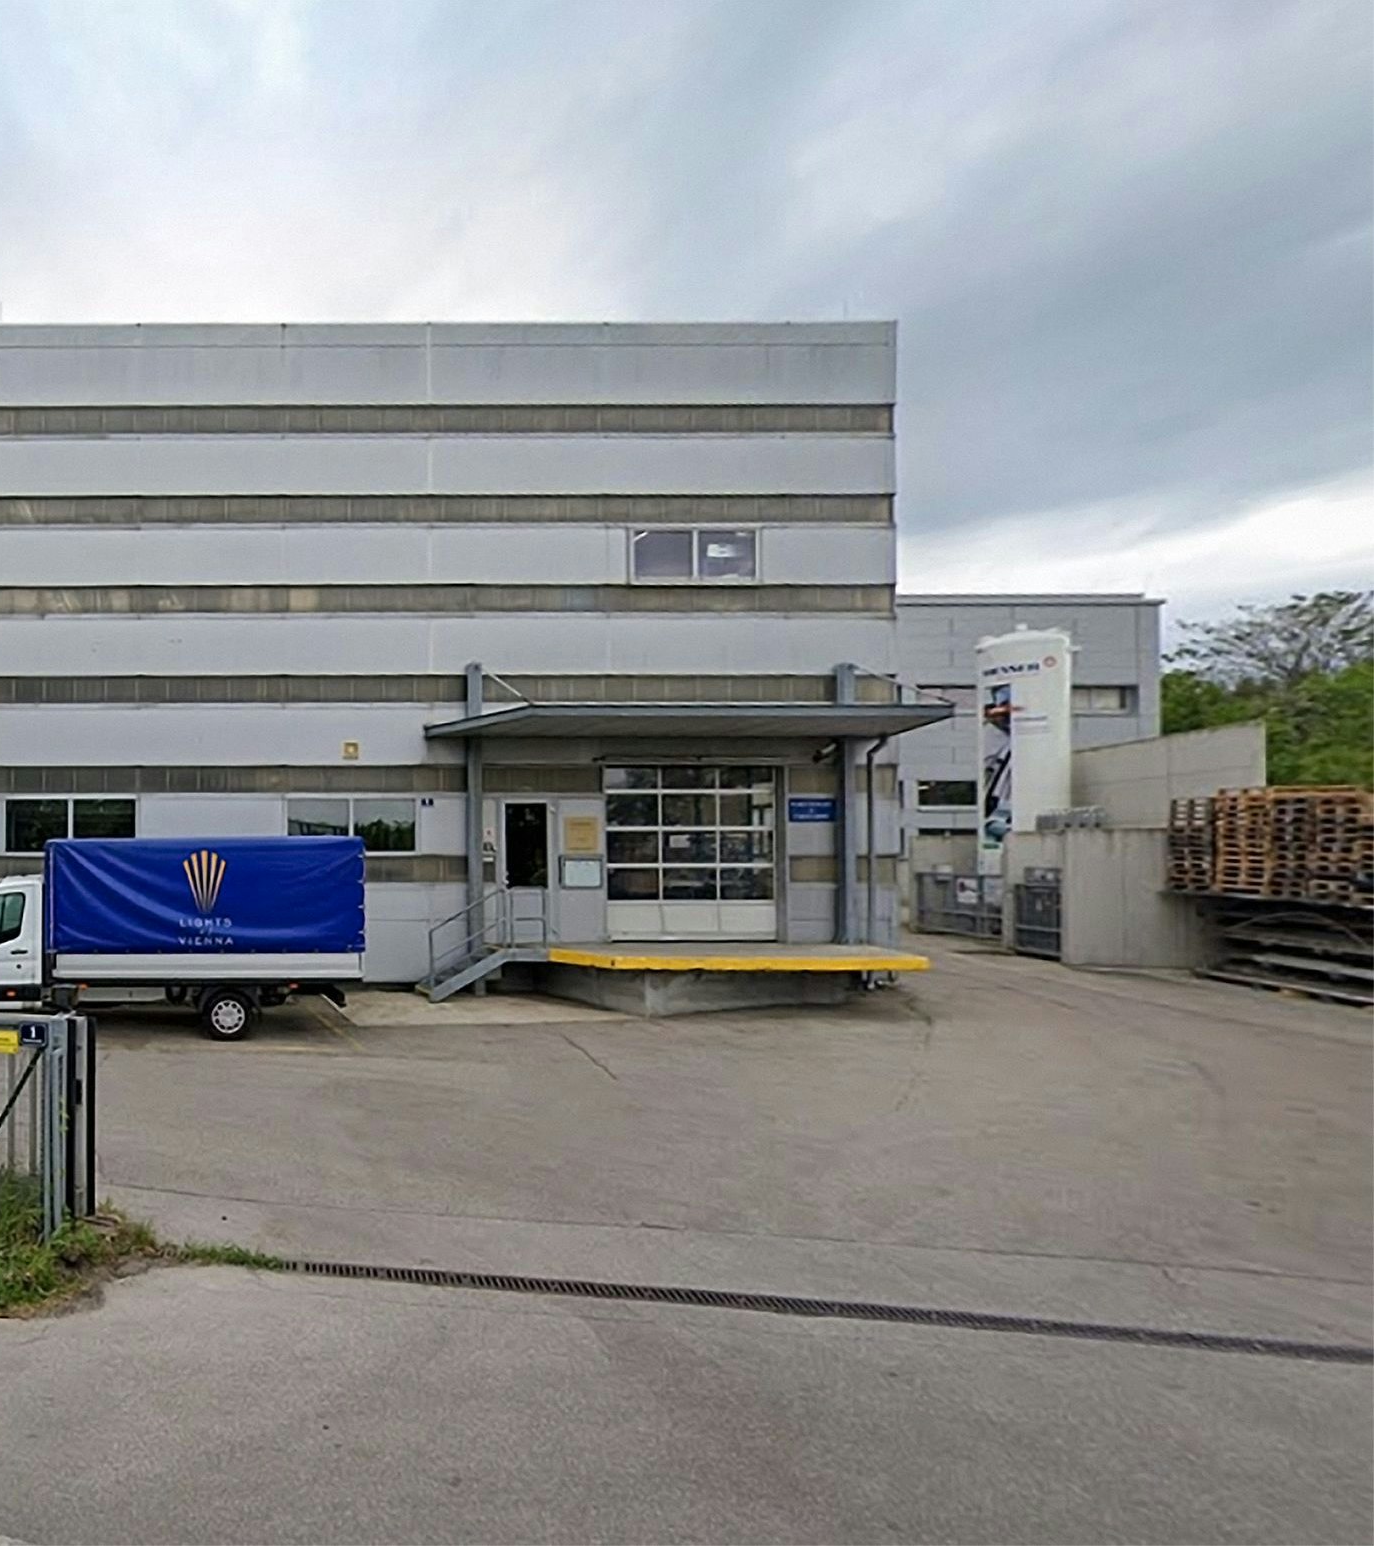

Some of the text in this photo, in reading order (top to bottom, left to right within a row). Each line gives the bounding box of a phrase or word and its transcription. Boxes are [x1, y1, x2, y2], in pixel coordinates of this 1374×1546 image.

[179, 917, 232, 927] LIGHTS
[178, 936, 233, 946] VIENNA
[30, 1025, 36, 1039] 1
